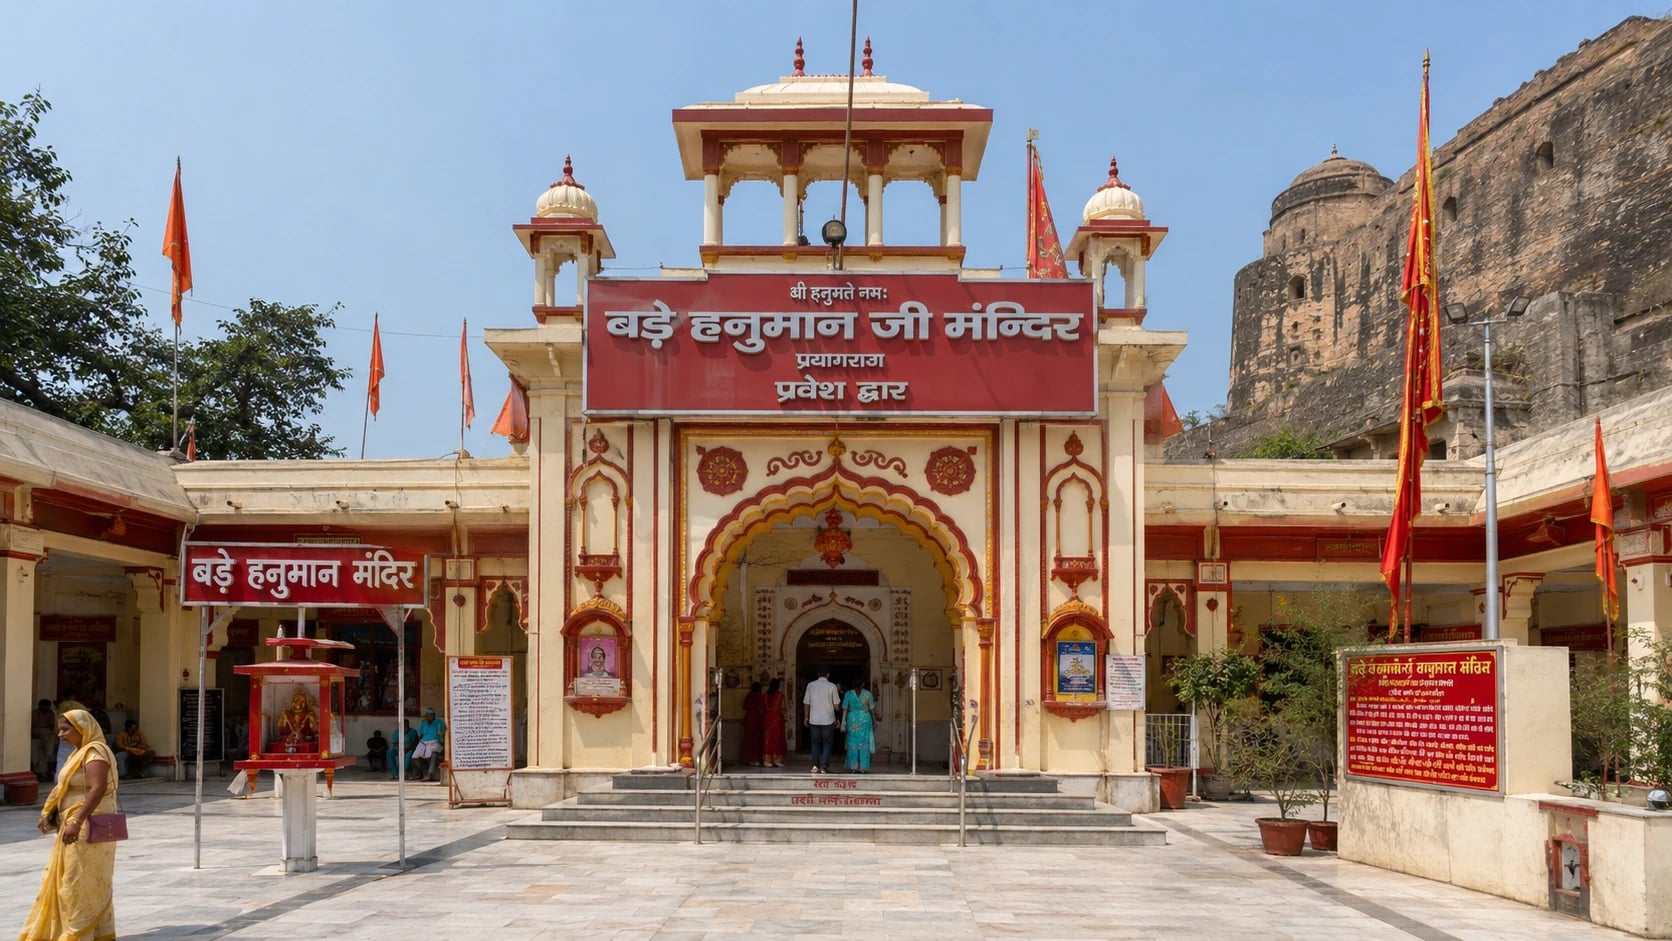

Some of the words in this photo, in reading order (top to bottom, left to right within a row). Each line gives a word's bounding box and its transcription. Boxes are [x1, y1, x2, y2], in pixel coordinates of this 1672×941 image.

[810, 282, 855, 306] हनुमते
[858, 286, 888, 301] नमः
[605, 300, 677, 349] बड़े
[688, 310, 859, 354] हनुमान
[868, 300, 934, 341] जी
[774, 374, 847, 403] प्रवेश
[856, 381, 909, 403] द्वार
[192, 548, 236, 594] बड़े
[246, 558, 342, 599] हनुमान
[352, 549, 418, 589] मंदिर
